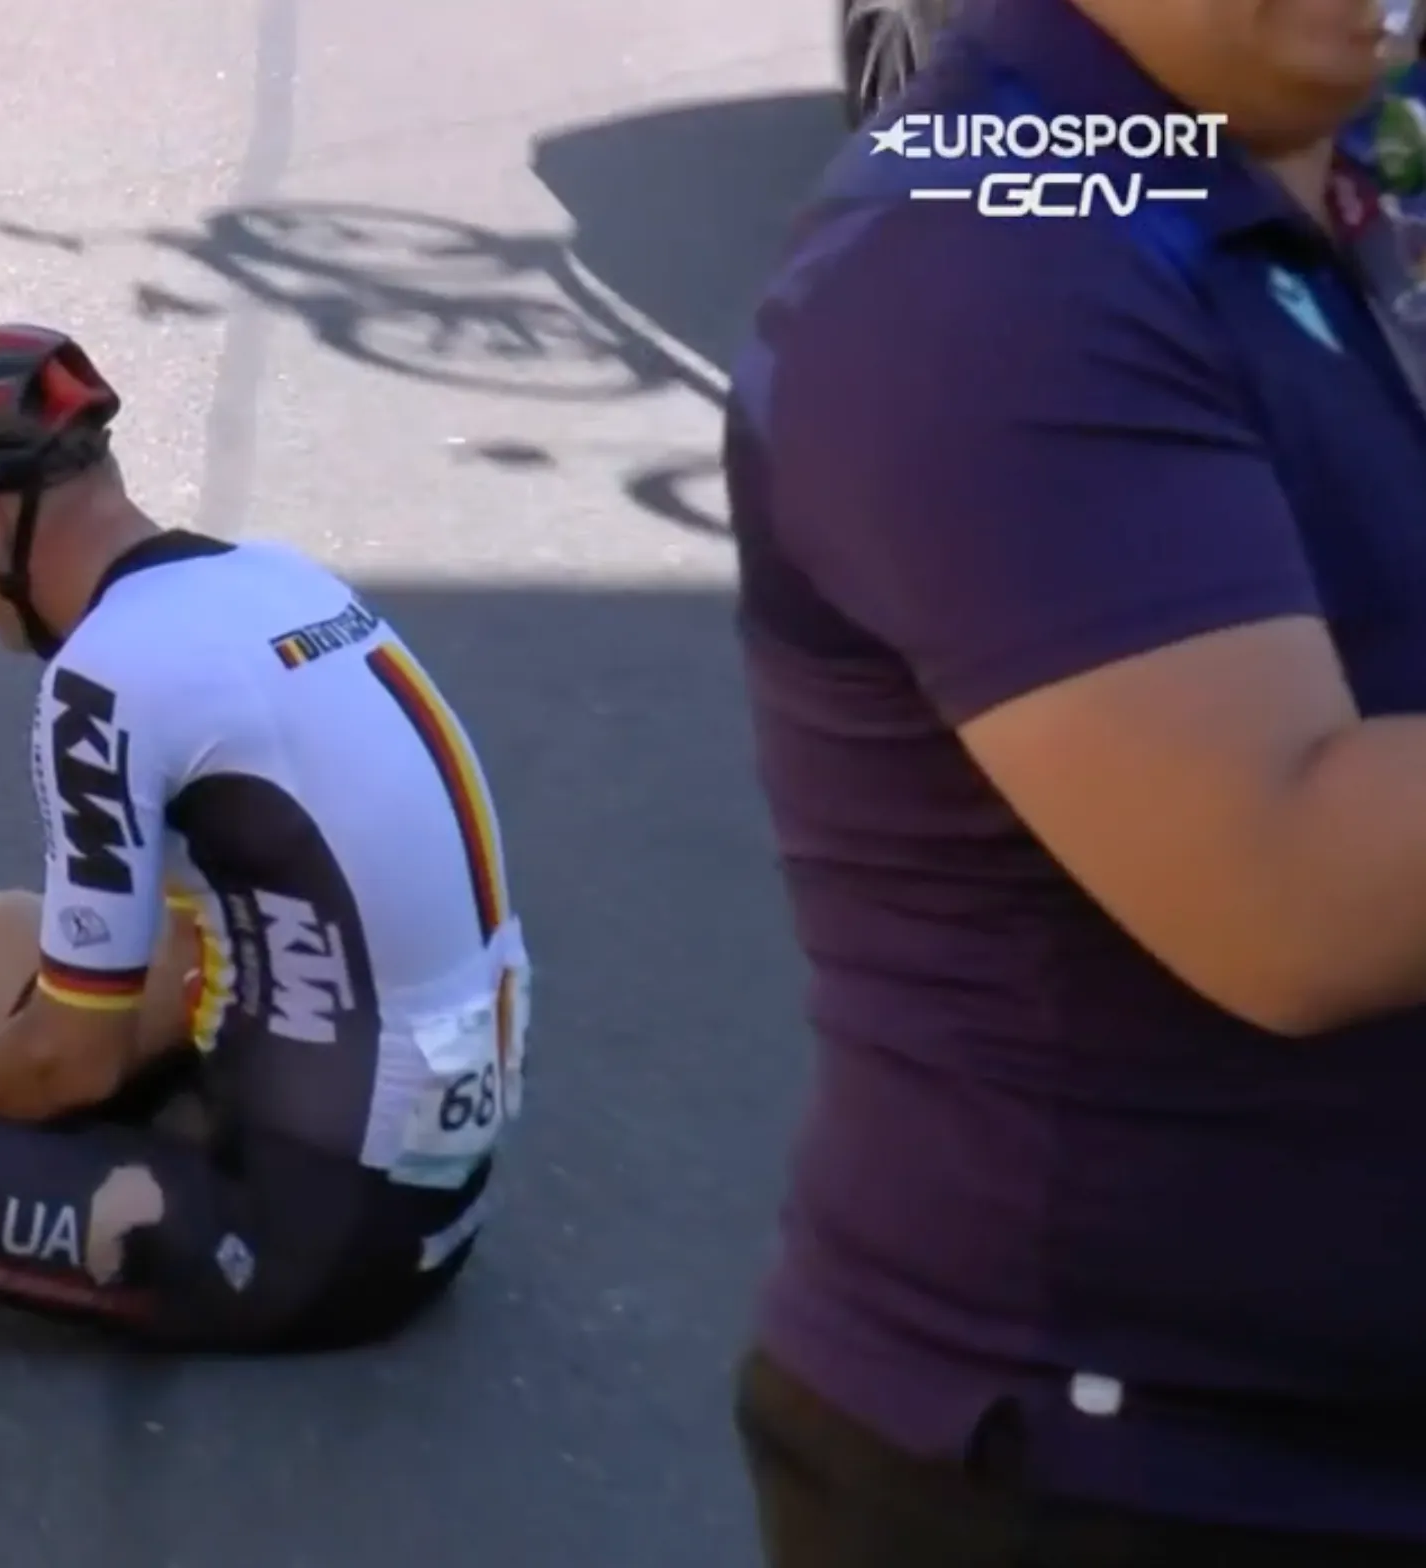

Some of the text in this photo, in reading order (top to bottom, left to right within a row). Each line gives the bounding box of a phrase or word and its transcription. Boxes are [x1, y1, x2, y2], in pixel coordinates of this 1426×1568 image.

[52, 666, 145, 895] KTM
[253, 888, 355, 1043] KTM
[440, 1063, 495, 1132] 68
